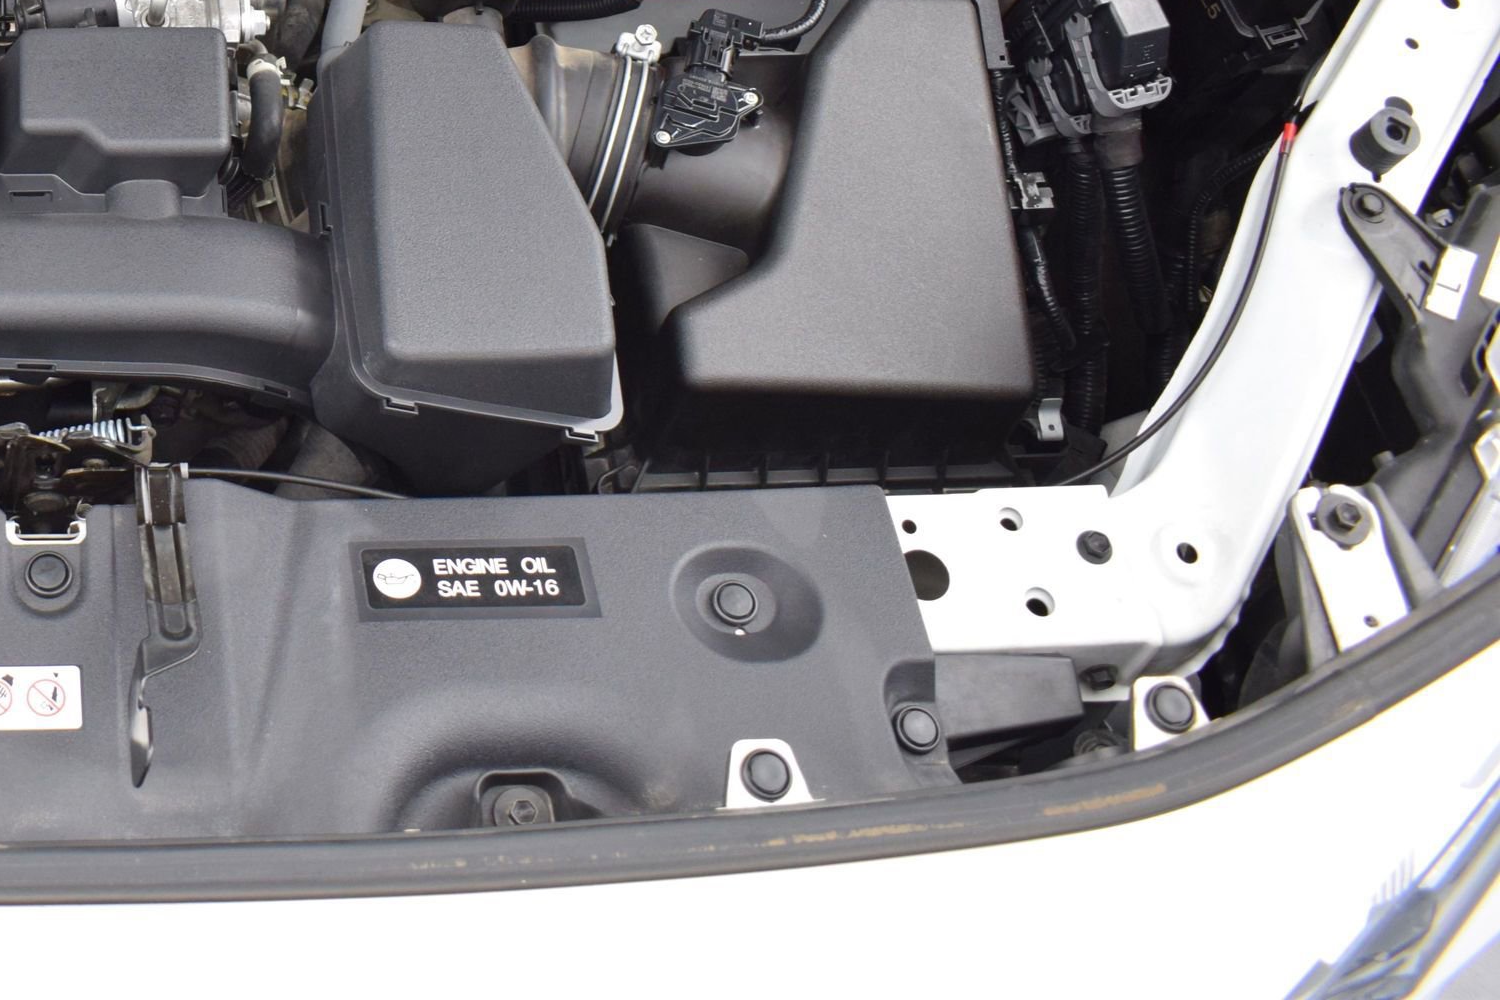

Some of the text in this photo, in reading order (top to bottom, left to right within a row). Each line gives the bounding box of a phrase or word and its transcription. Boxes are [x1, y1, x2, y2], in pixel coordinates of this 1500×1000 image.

[432, 556, 556, 575] ENGINE OIL
[437, 578, 560, 597] SAE 0W-16
